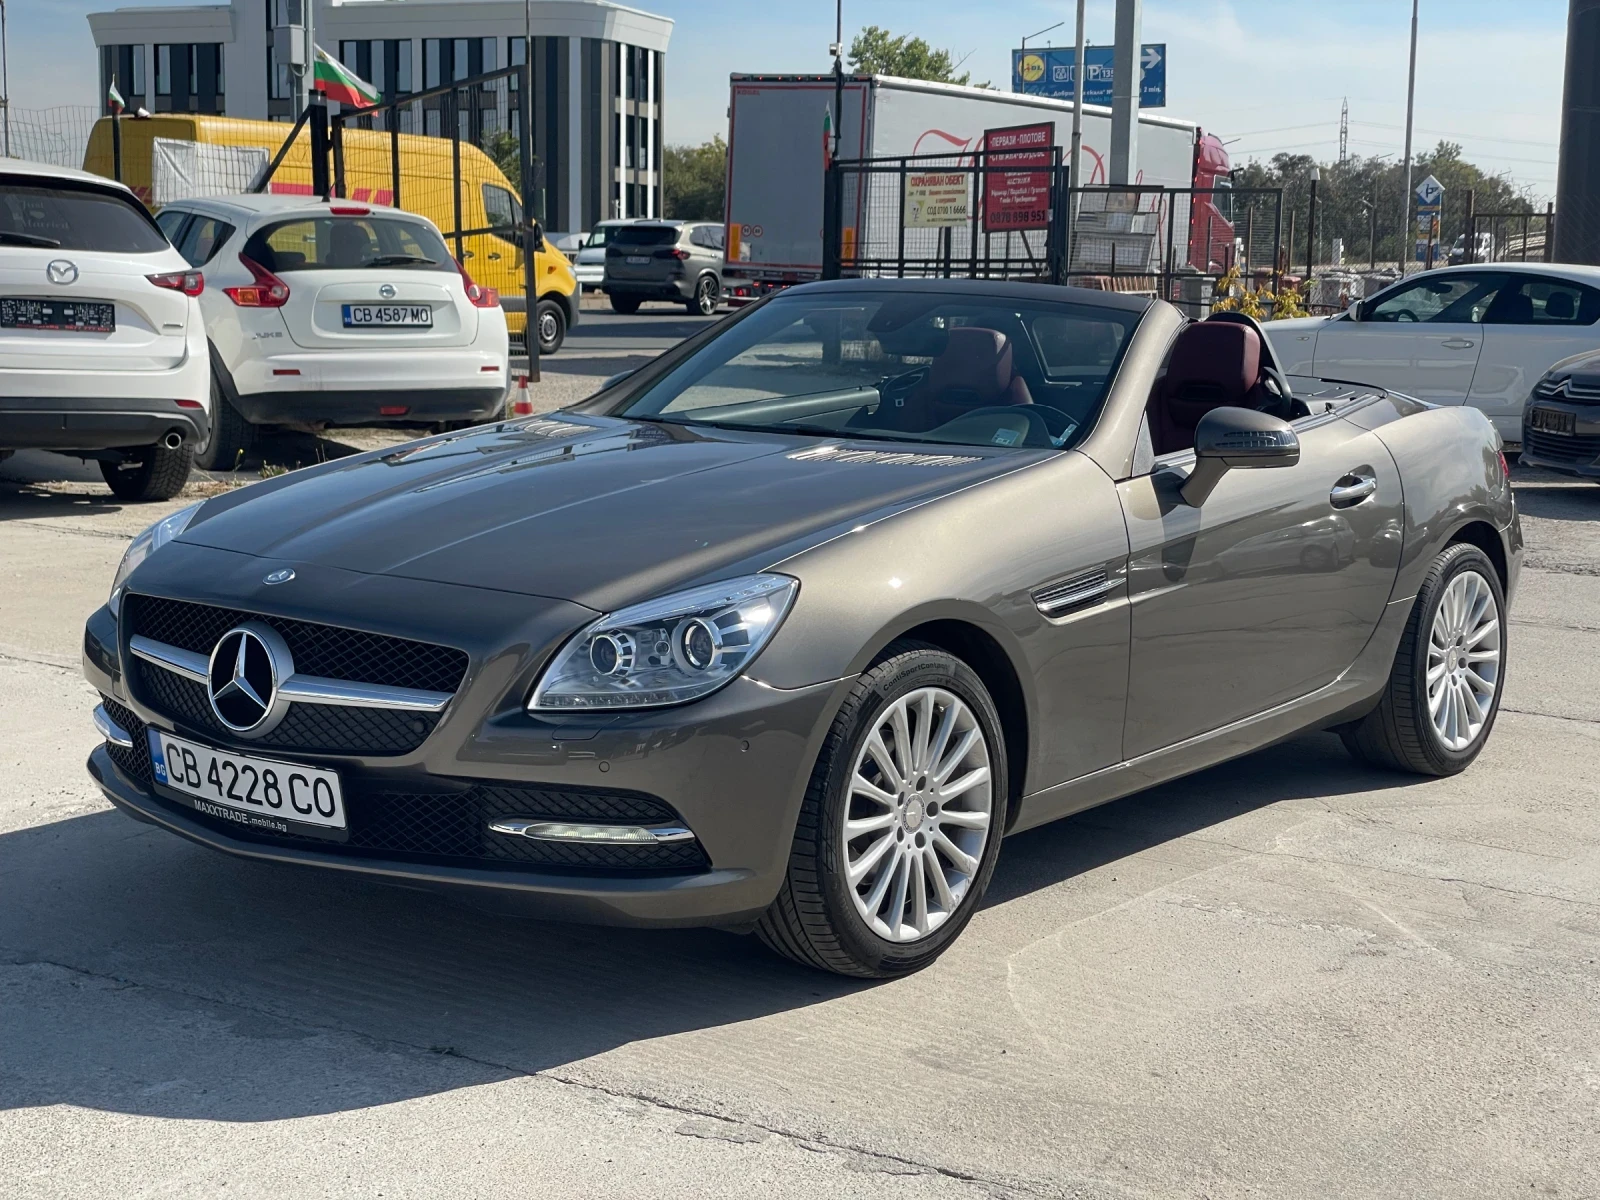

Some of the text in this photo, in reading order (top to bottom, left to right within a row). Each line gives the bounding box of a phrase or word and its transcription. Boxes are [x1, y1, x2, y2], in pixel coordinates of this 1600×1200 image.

[911, 174, 965, 187] ОХРАНЯВАН ОБЕКТ
[927, 206, 937, 215] СОД
[937, 206, 948, 215] 0700
[1031, 210, 1046, 221] 951
[353, 308, 372, 322] CB
[375, 308, 408, 322] 4587
[411, 308, 428, 322] MO
[252, 331, 283, 340] JUKE
[155, 742, 336, 818] BG CB 4228 CO
